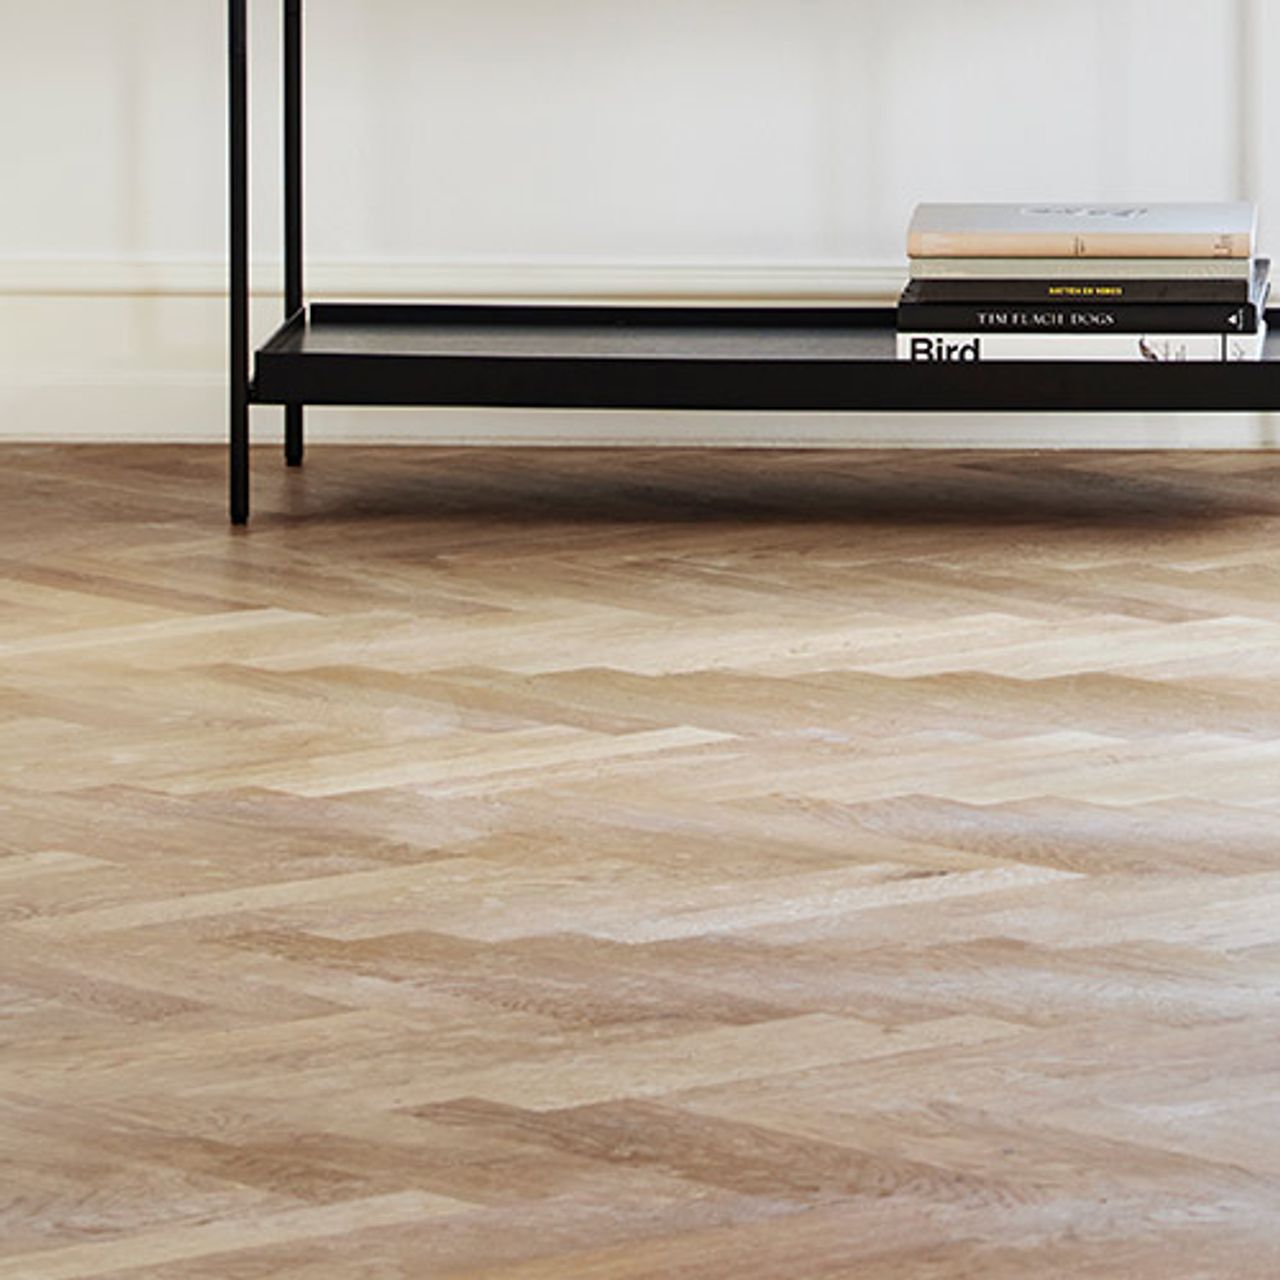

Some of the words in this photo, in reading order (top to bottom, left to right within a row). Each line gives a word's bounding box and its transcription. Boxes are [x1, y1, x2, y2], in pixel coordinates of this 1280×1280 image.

[976, 312, 1008, 325] TIM
[1070, 312, 1115, 326] DOGS
[910, 338, 980, 361] Bird
